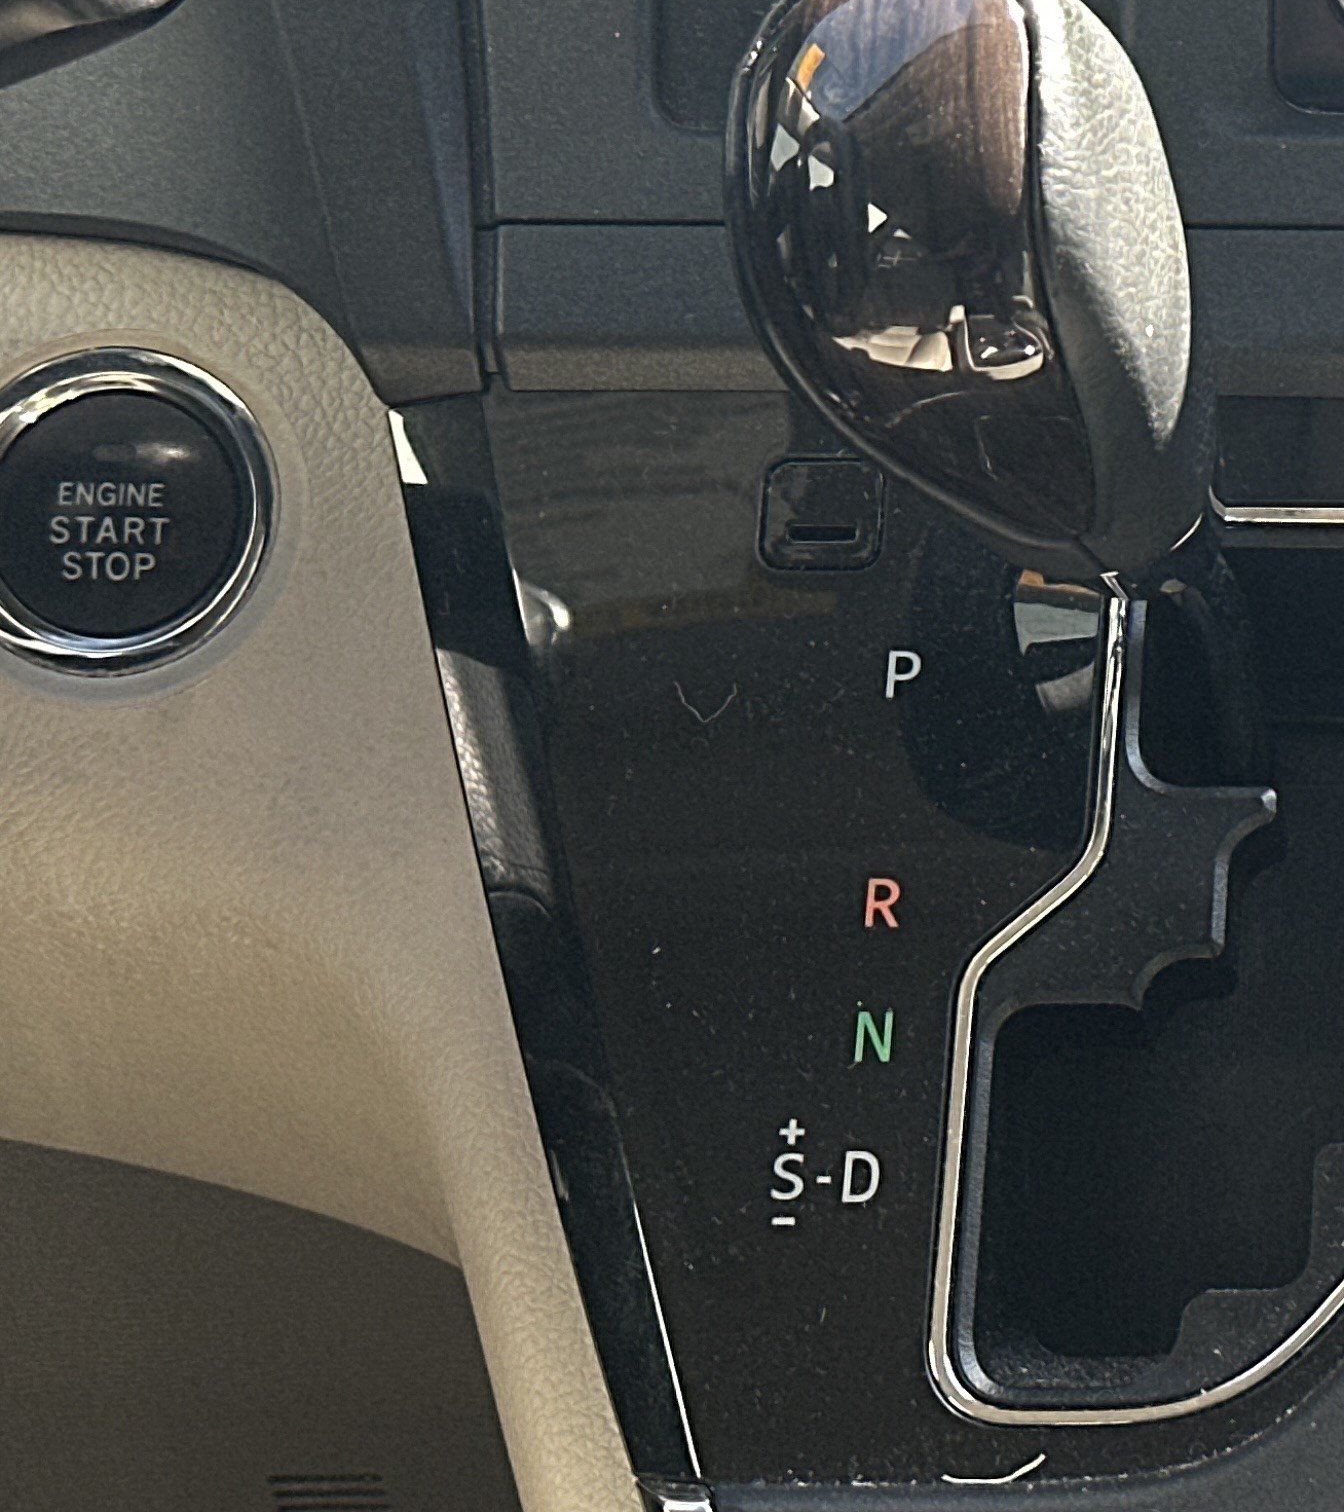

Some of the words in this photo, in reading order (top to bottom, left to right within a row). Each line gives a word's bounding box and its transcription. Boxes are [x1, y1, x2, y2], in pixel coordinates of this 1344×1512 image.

[58, 482, 166, 508] ENGINE
[50, 516, 170, 545] START
[62, 552, 156, 581] STOP
[885, 650, 922, 699] P
[864, 877, 900, 928] R
[853, 1010, 895, 1063] N
